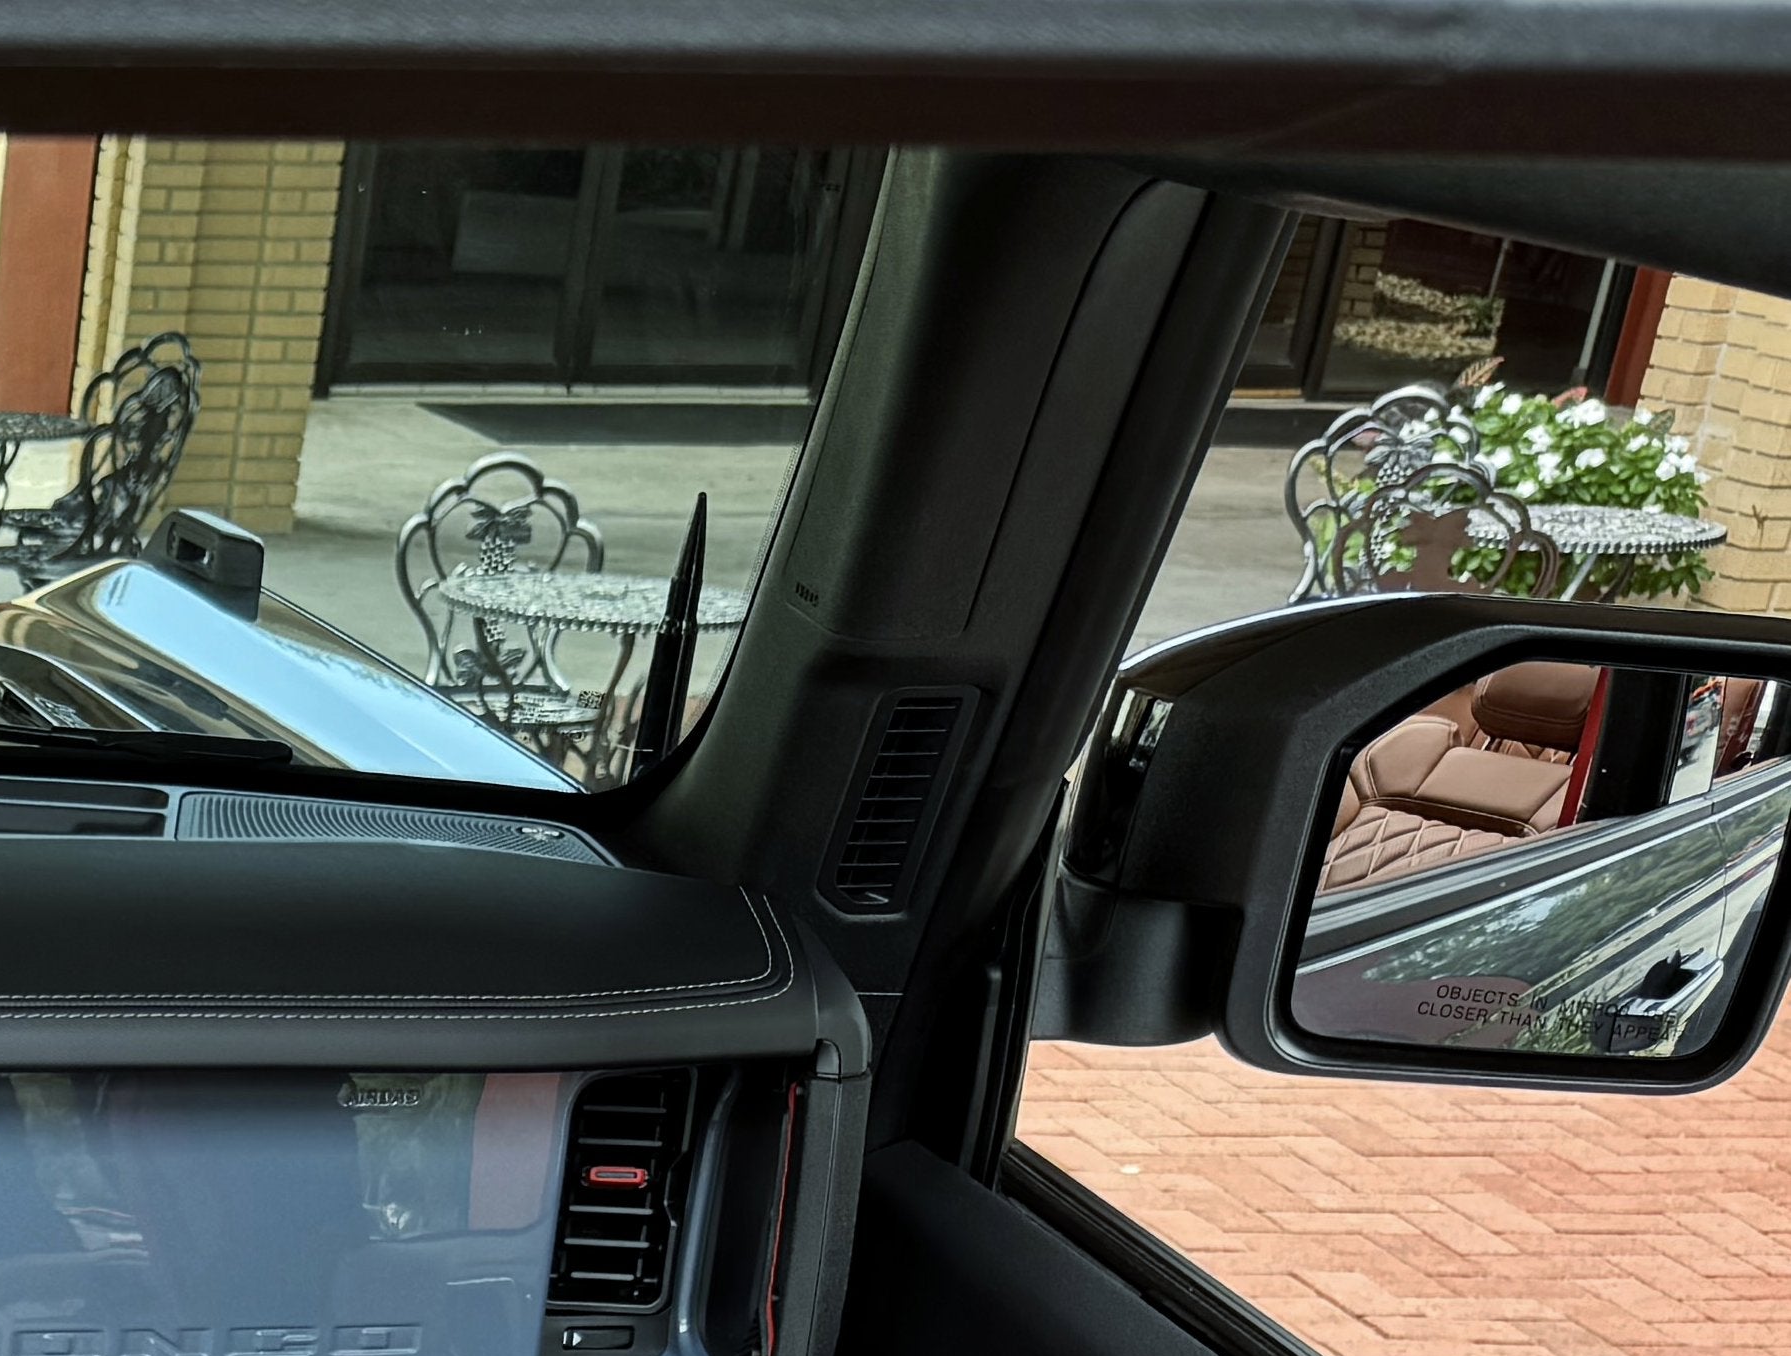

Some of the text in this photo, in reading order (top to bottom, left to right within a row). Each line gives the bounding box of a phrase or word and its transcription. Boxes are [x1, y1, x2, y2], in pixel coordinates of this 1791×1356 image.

[1436, 984, 1520, 1008] OBJECTS
[1530, 993, 1547, 1011] IN
[1417, 1001, 1489, 1024] CLOSER
[1500, 1010, 1547, 1032] THAN
[1556, 1016, 1603, 1036] THEY
